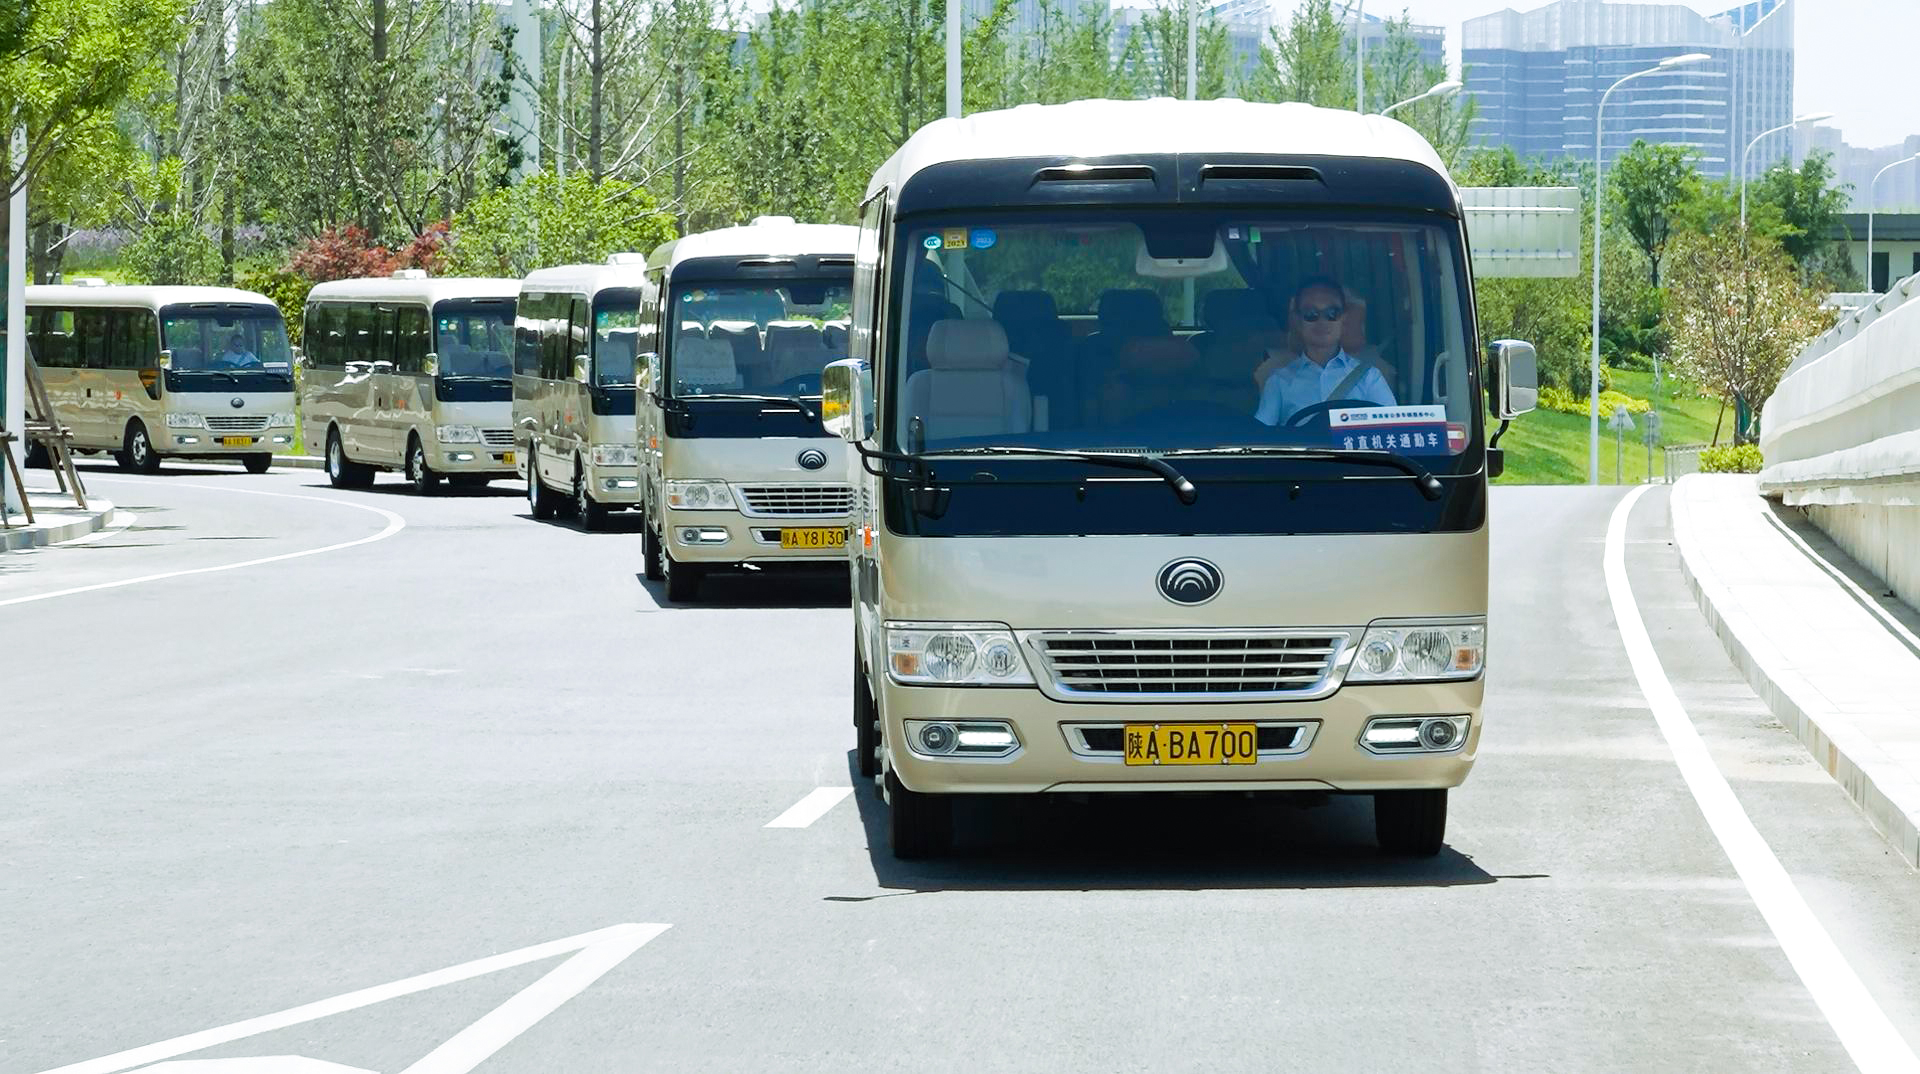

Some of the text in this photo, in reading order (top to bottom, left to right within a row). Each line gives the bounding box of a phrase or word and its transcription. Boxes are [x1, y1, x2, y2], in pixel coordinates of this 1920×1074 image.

[1343, 432, 1438, 450] 省直机关通勤车
[1128, 730, 1254, 759] 陕A·BA700
